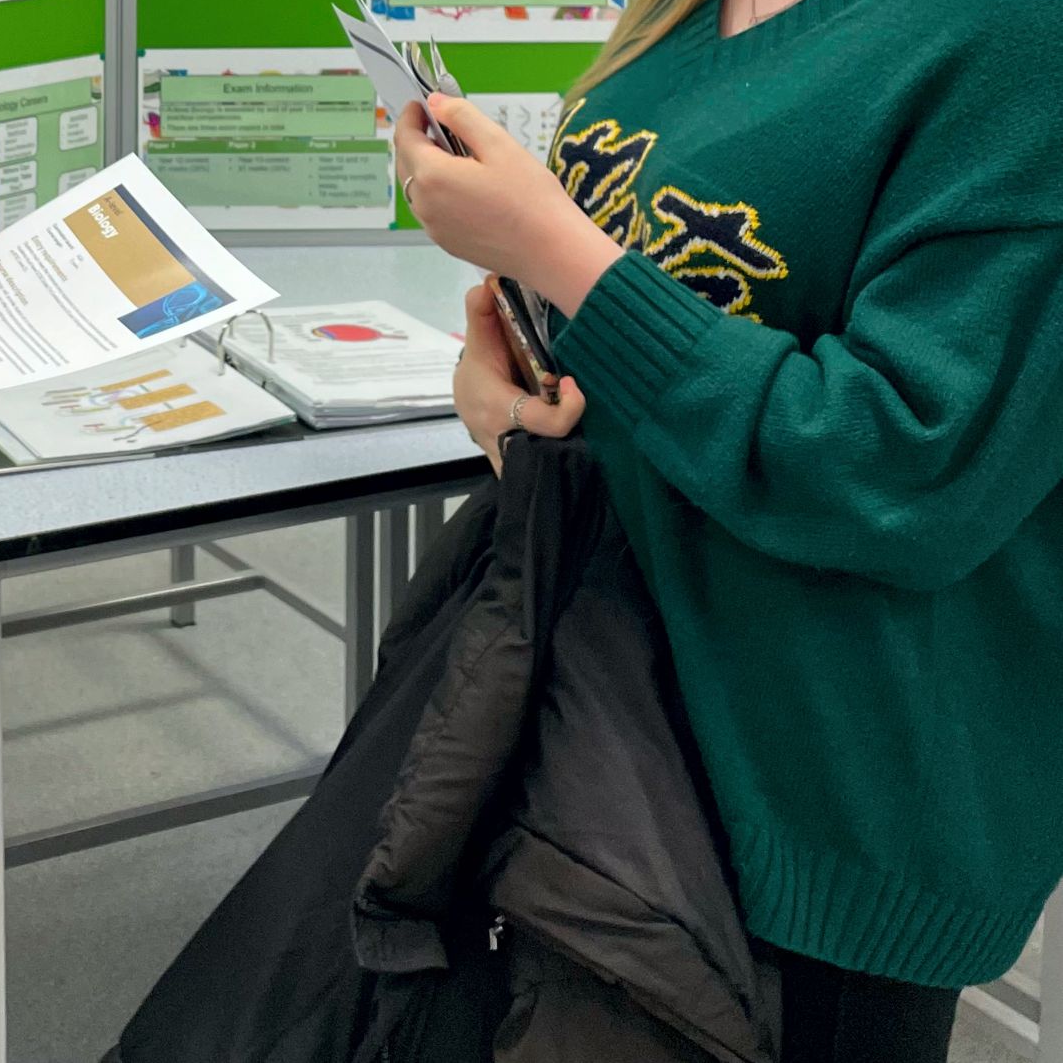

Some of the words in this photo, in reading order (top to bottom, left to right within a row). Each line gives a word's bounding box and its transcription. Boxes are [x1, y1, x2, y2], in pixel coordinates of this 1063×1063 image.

[223, 83, 252, 94] Exam
[256, 83, 313, 94] Information
[20, 96, 48, 107] Careers
[87, 203, 119, 238] Biology
